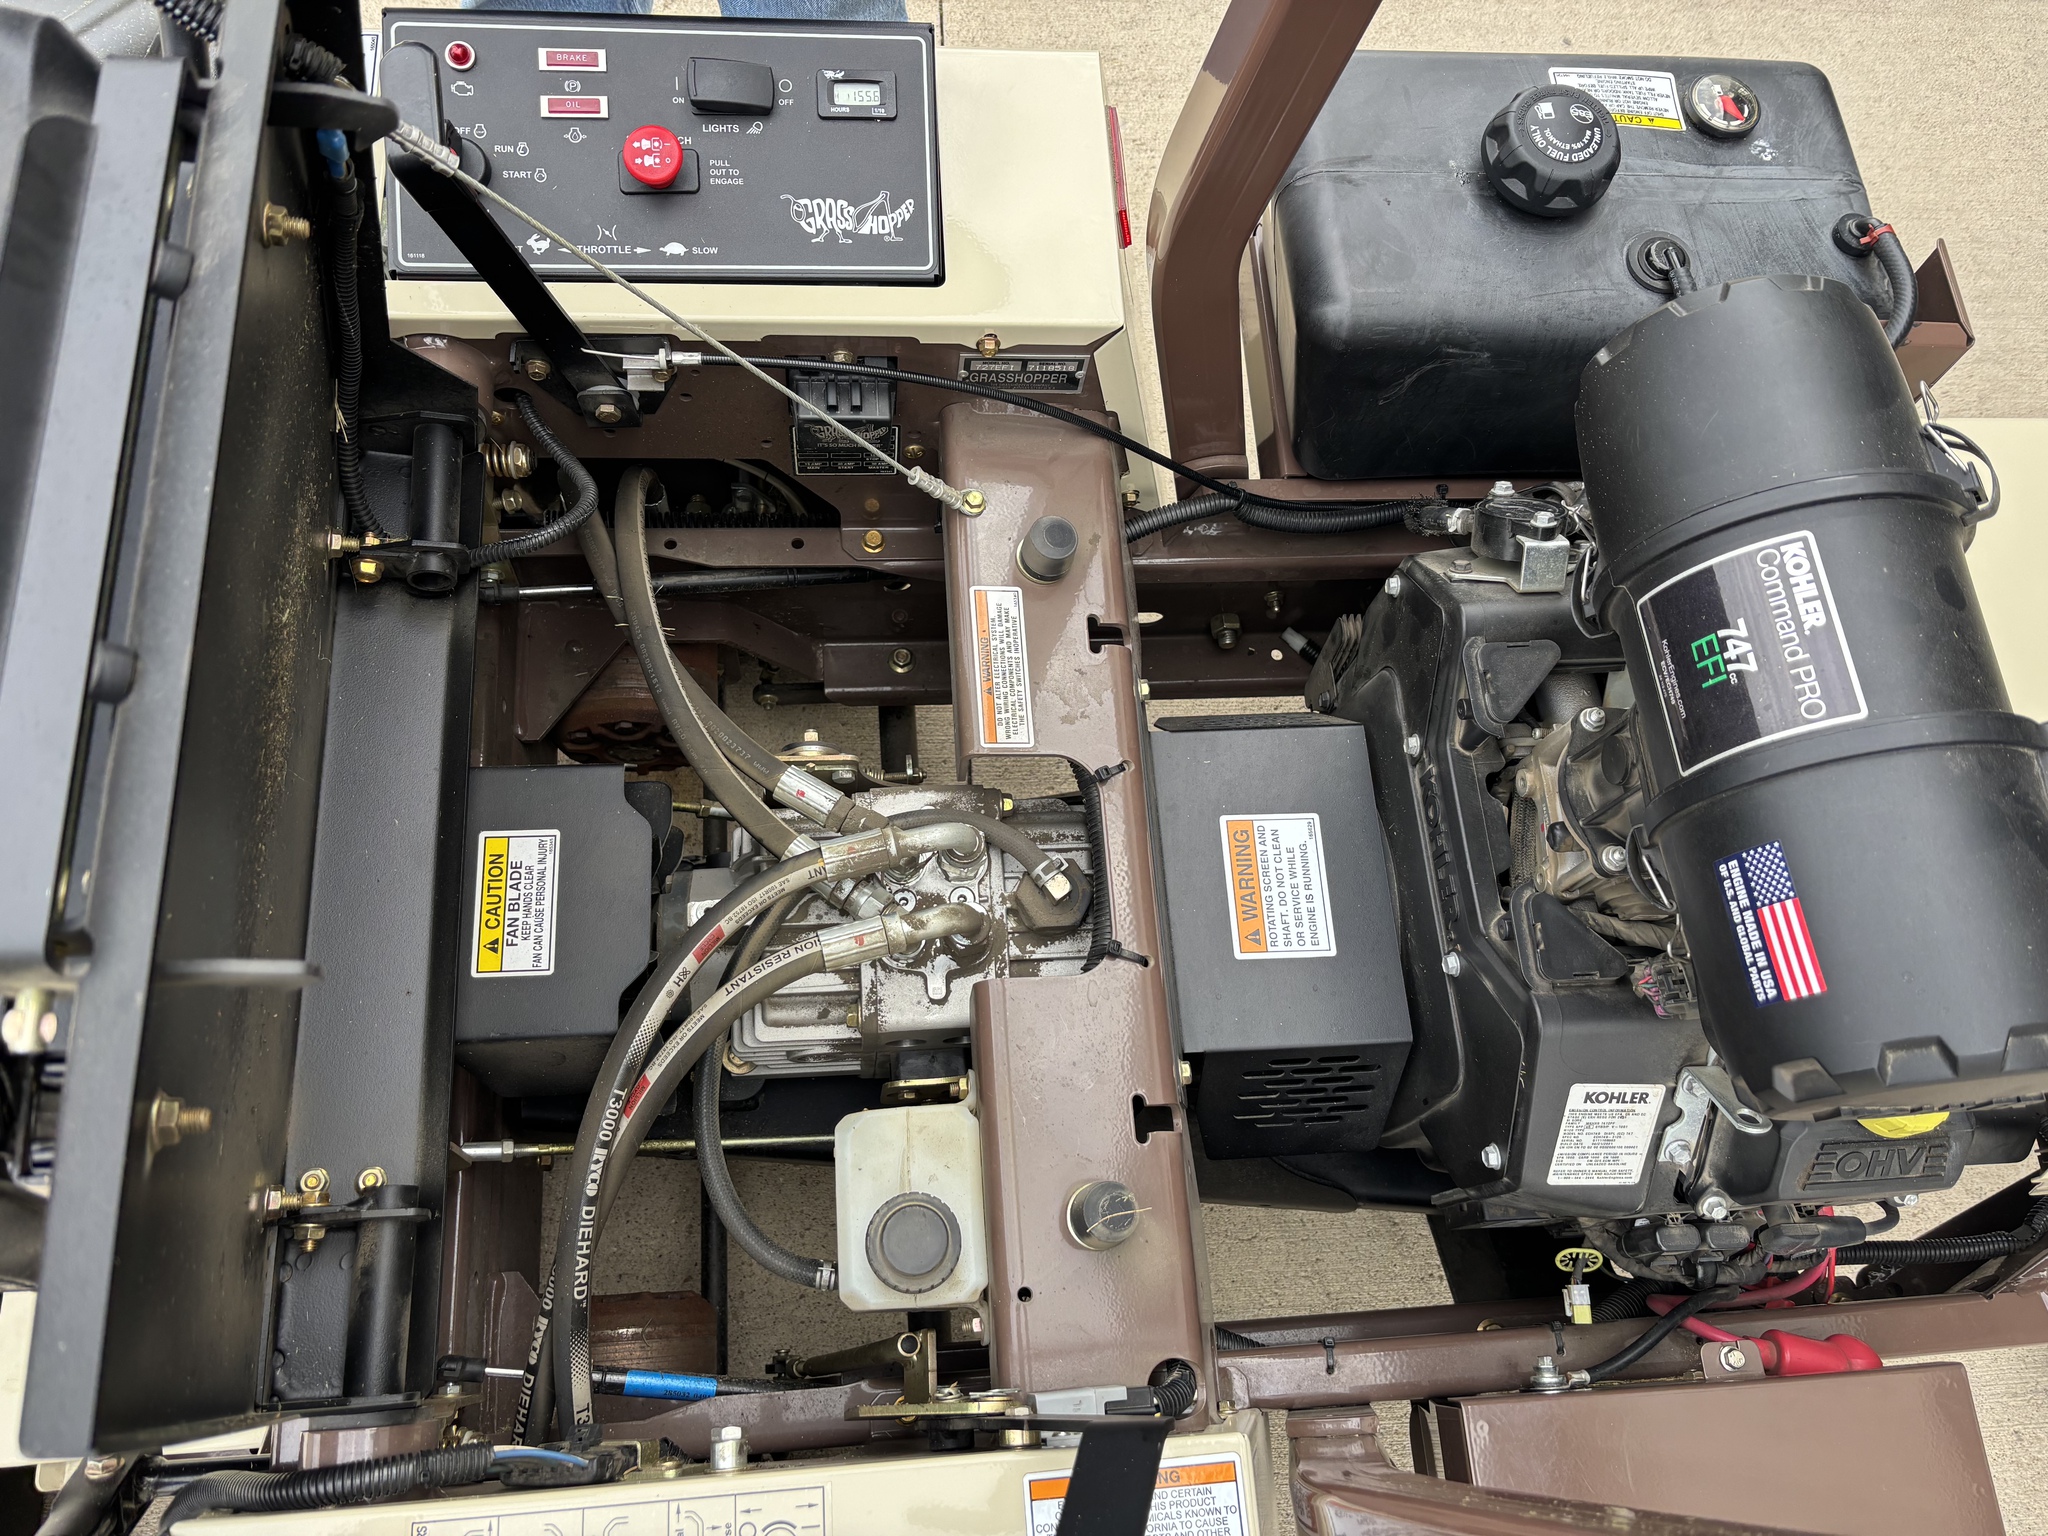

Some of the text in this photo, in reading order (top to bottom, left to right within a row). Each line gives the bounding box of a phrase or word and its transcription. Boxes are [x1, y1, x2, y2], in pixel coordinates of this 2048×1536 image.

[556, 53, 588, 62] BRAKE
[565, 101, 581, 109] OIL
[1613, 115, 1642, 123] CAUT
[702, 124, 740, 133] LIGHTS
[1530, 124, 1601, 162] UNLEADED FUEL ONLY
[1544, 128, 1592, 149] MAX 10% ETHANOL
[494, 145, 514, 153] RUN
[709, 159, 731, 167] PULL
[502, 170, 532, 179] START
[577, 245, 632, 254] THROTTLE
[692, 246, 718, 255] SLOW
[969, 372, 1068, 384] GRASSHOPPER
[1011, 615, 1020, 653] INOPERATIVE
[1756, 548, 1827, 719] Command PRO
[980, 637, 992, 683] WARNING
[1000, 647, 1008, 688] CONNECTIONS
[1007, 656, 1015, 696] COMPONENTS
[1014, 656, 1022, 686] SWITCHES
[1661, 638, 1687, 719] KohlerEngines.com
[1691, 633, 1727, 689] EFI
[997, 717, 1004, 726] DO
[1011, 700, 1019, 735] ELECTRICAL
[485, 853, 504, 930] CAUTION
[767, 887, 786, 901] MEETS
[1233, 829, 1259, 922] WARNING
[1257, 825, 1279, 947] ROTATING SCREEN AND
[1270, 829, 1292, 947] SHAFT. DO NOT CLEAN
[1298, 840, 1320, 946] ENGINE IS RUNNING.
[506, 860, 523, 947] FAN BLADE
[521, 865, 535, 941] KEEP HANDS CLEAR
[532, 838, 548, 968] FAN CAN CAUSE PERSONAL INJURY
[735, 904, 759, 925] EXCEEDS
[1286, 846, 1306, 947] OR SERVICE WHILE
[1718, 863, 1767, 1003] OF U.S. AND GLOBAL PARTS
[1727, 859, 1778, 1000] ENGINE MADE IN USA
[724, 949, 792, 998] RESISTANT
[599, 1087, 628, 1141] T3000
[585, 1147, 611, 1197] RYCO
[511, 1314, 549, 1446] RYCO DIEHAR
[663, 1389, 690, 1398] 285032
[1150, 1496, 1216, 1511] HIS PRODUCT
[1170, 1486, 1213, 1499] CERTAIN
[1036, 1517, 1229, 1534] CON ORNIA TO CAUSE
[1184, 1508, 1222, 1521] KNOWN
[1224, 1504, 1238, 1515] TO
